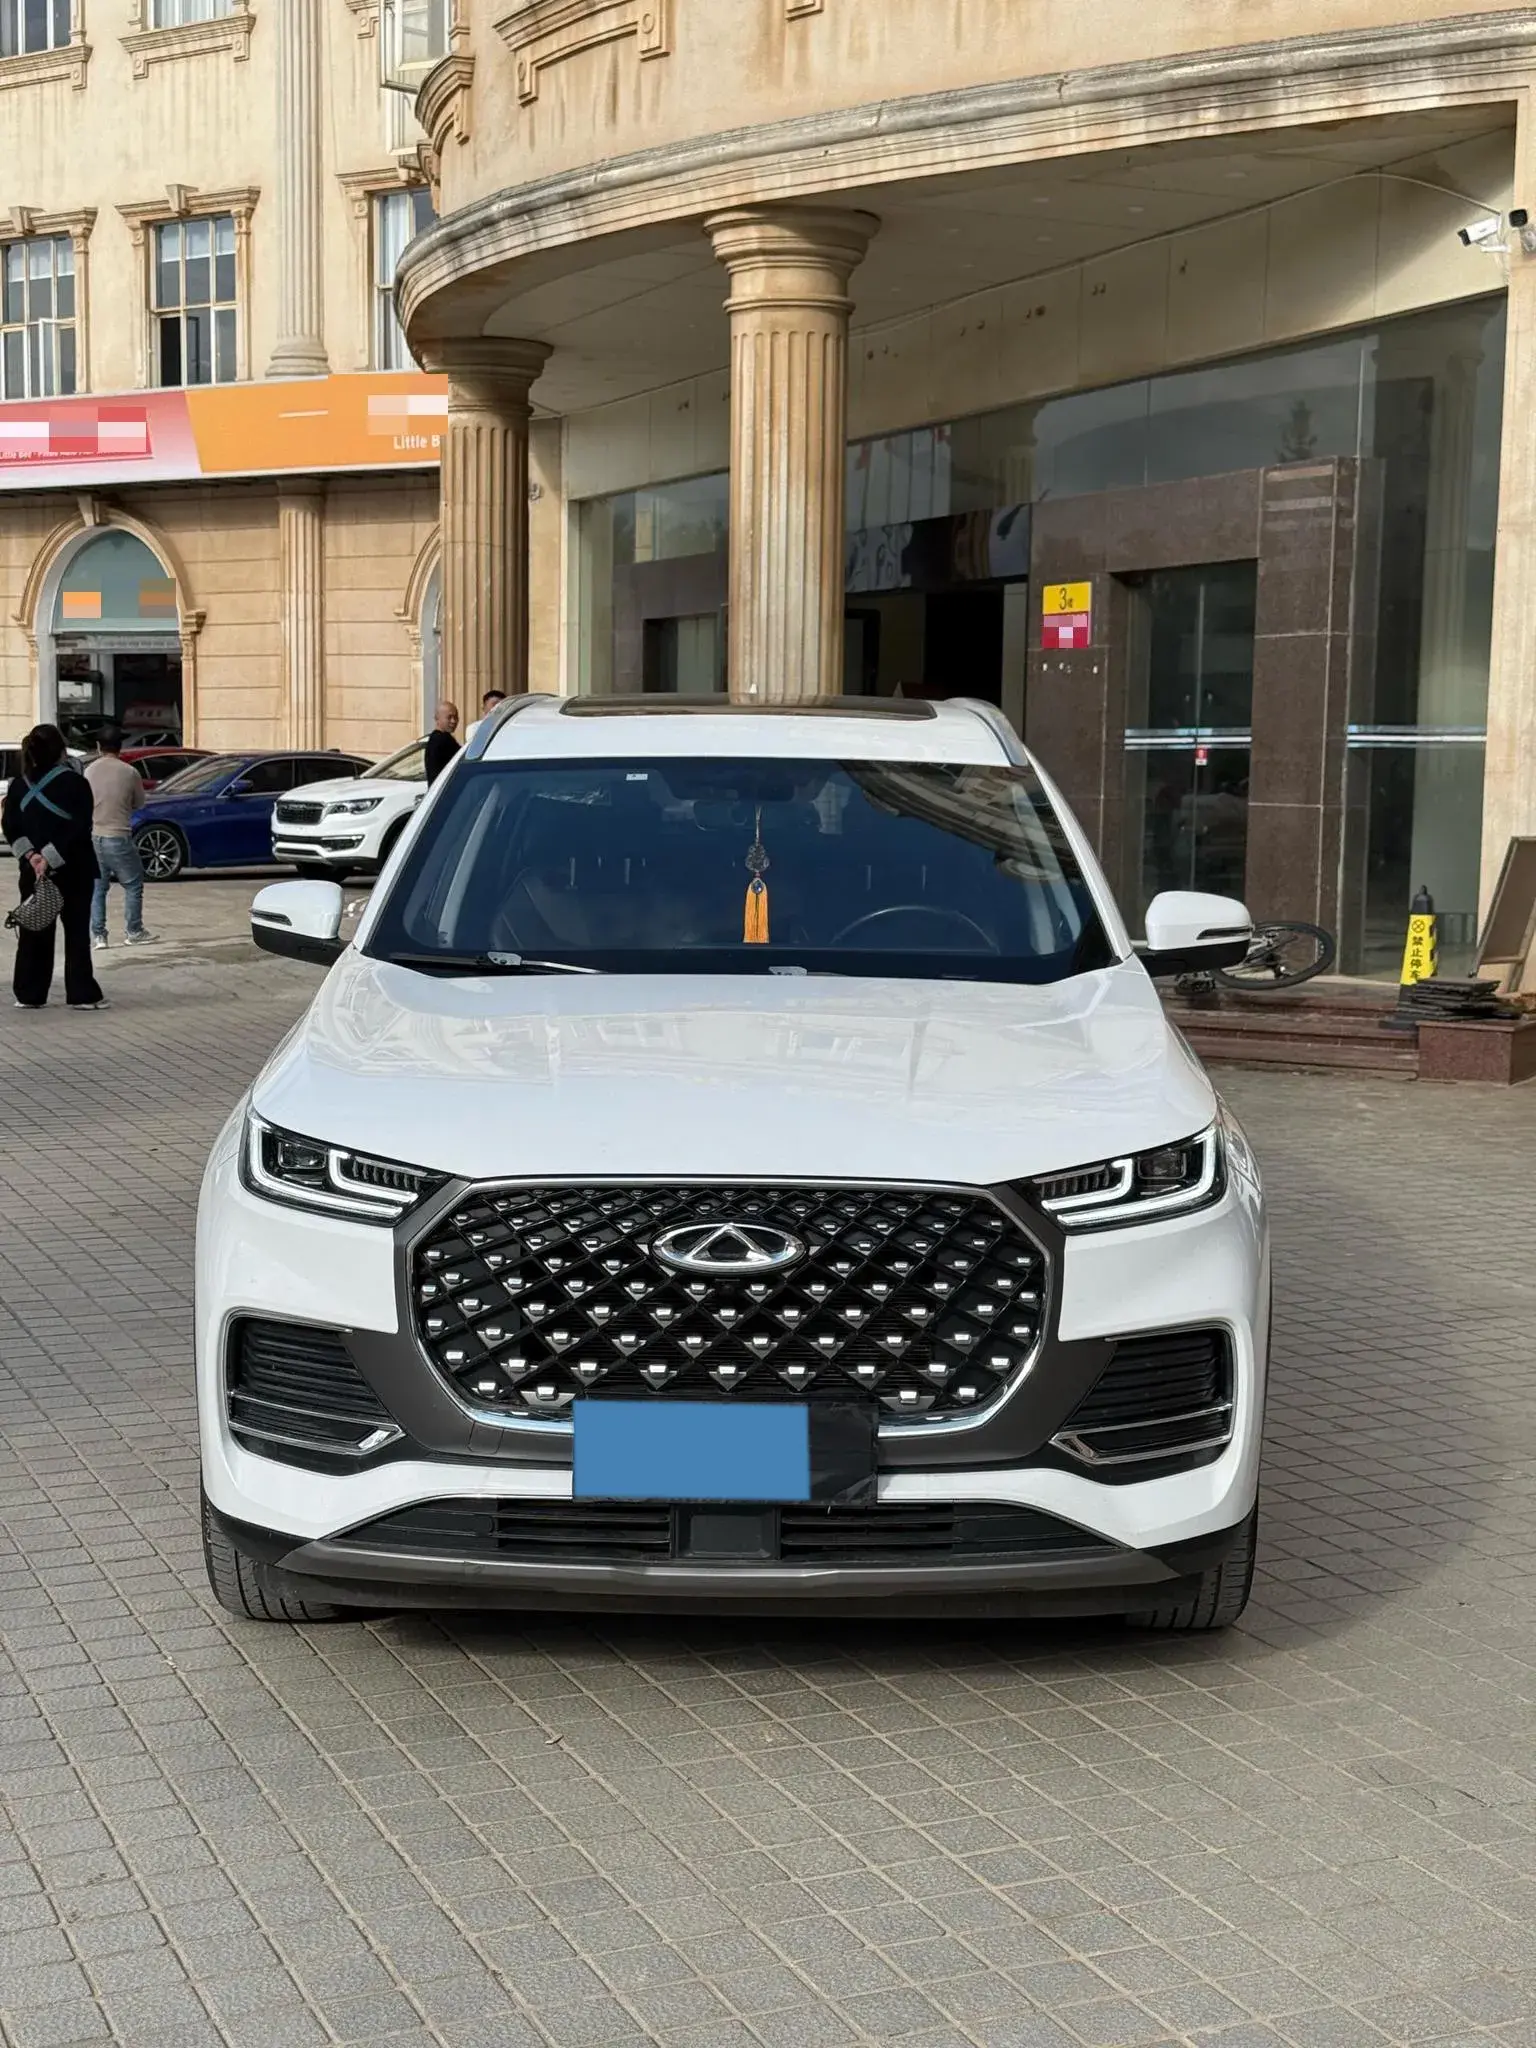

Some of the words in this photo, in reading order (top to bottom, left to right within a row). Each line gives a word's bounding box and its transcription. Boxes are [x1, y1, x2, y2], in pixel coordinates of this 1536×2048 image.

[393, 434, 428, 450] Little
[1409, 936, 1424, 980] 禁止停车
